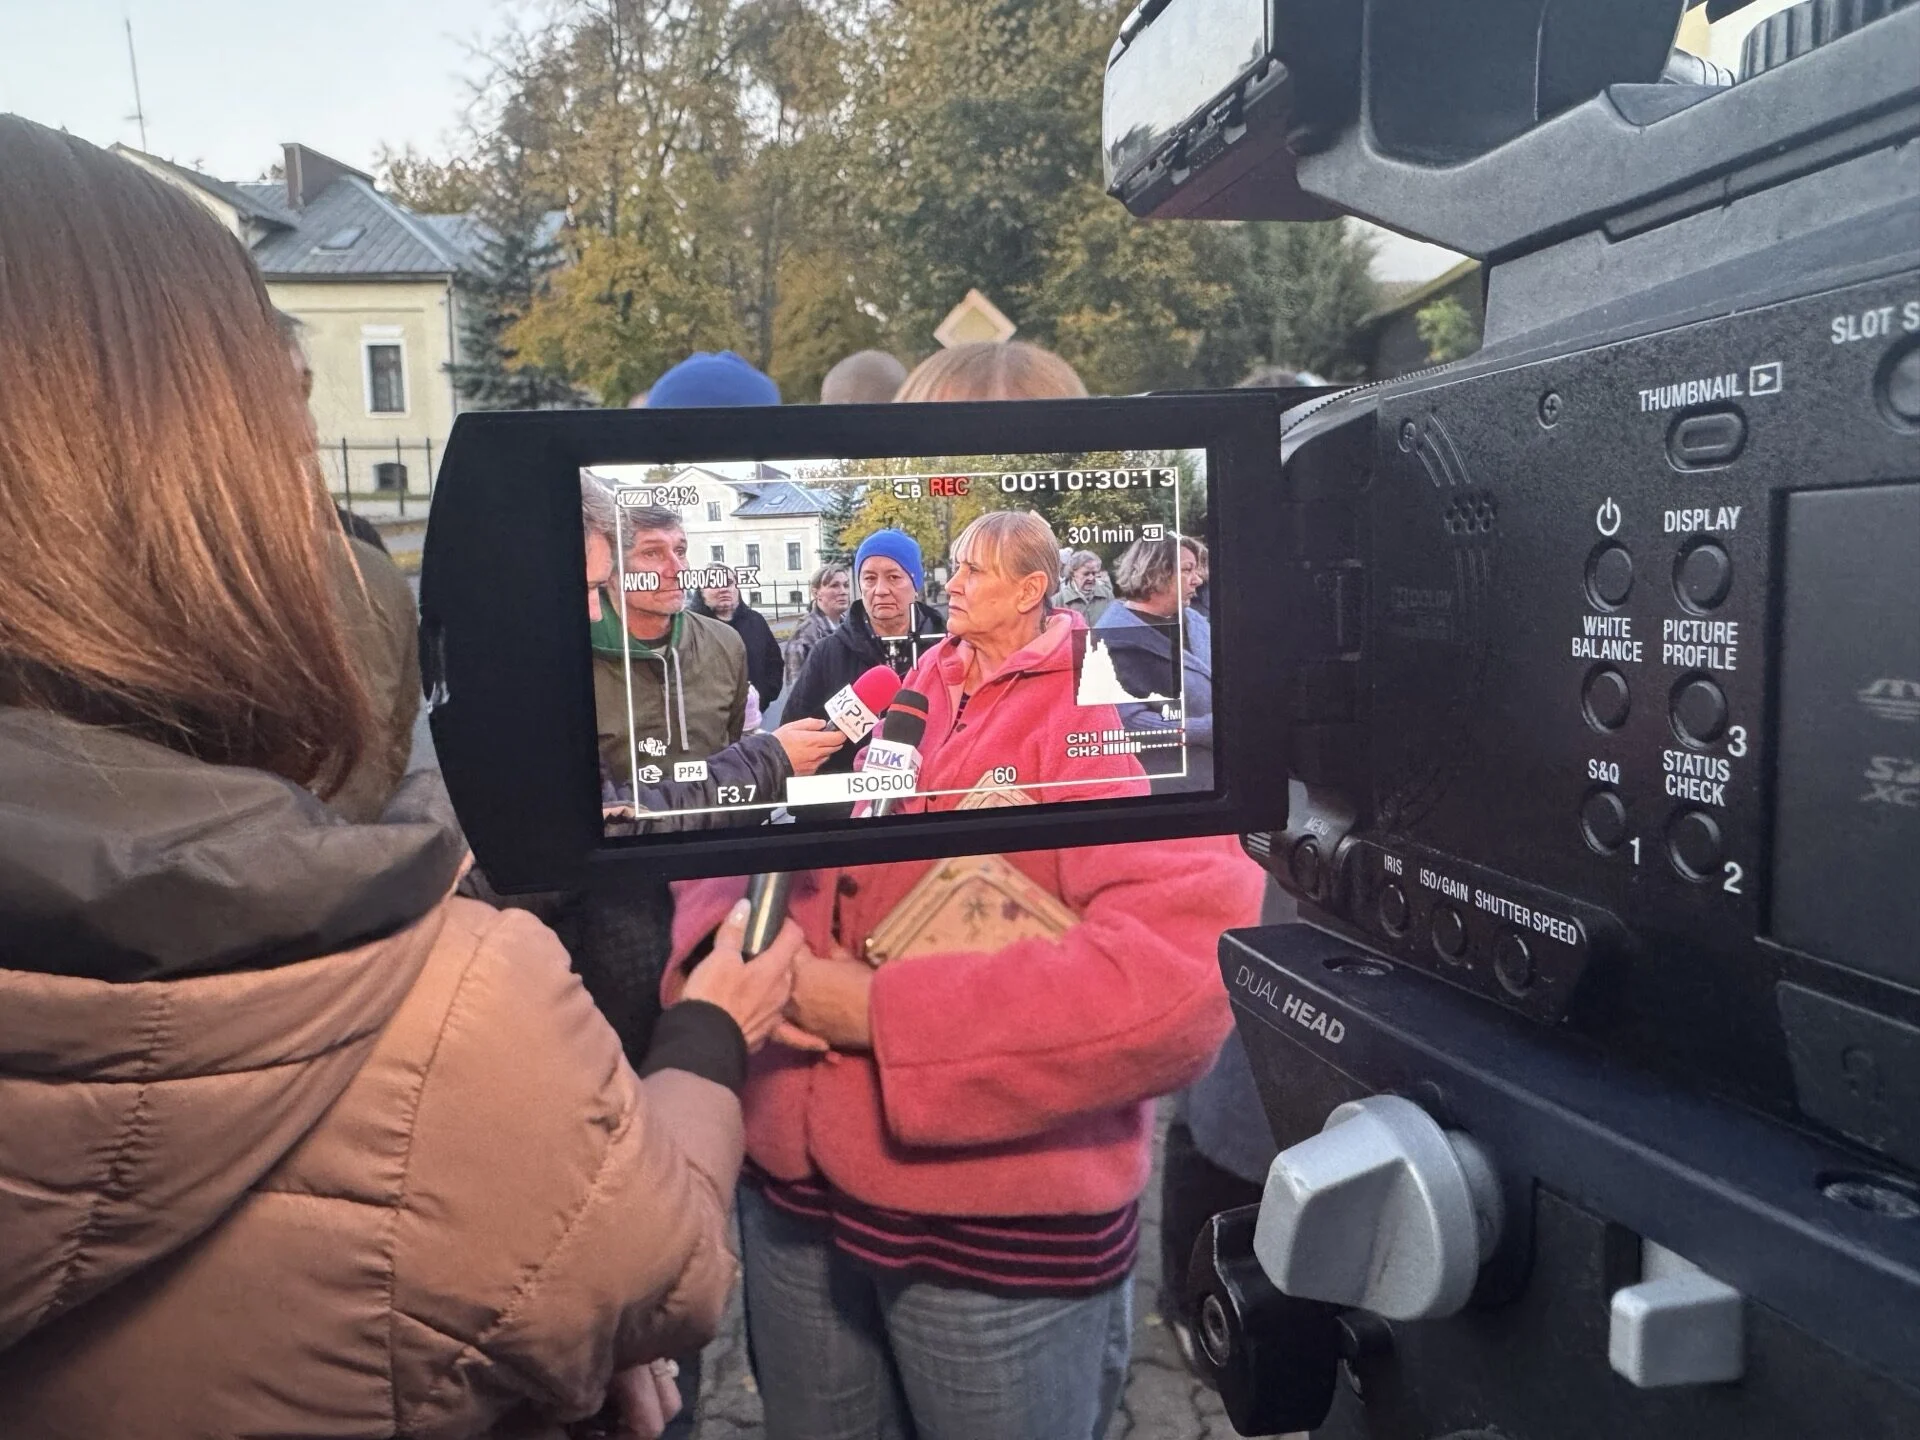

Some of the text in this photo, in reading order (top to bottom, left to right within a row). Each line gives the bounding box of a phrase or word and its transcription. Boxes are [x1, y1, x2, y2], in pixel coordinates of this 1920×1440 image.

[1831, 307, 1894, 345] SLOT
[1639, 373, 1744, 413] THUMBNAIL
[929, 476, 969, 497] REC
[1001, 469, 1175, 493] 00:10:30:13
[655, 487, 699, 506] 84%
[1664, 506, 1742, 533] DISPLAY
[623, 571, 660, 593] AVCHD
[676, 567, 729, 590] 1080/50i
[1583, 615, 1632, 639] WHITE
[1663, 619, 1739, 646] PICTURE
[1571, 637, 1643, 663] BALANCE
[1663, 644, 1737, 671] PROFILE
[1066, 731, 1098, 745] CH1
[1727, 725, 1748, 757] 3
[869, 748, 905, 768] TVK
[1066, 744, 1100, 758] CH2
[678, 766, 703, 778] PP4
[993, 766, 1017, 784] 60
[1588, 759, 1620, 785] S&Q
[1663, 750, 1730, 783] STATUS
[717, 784, 757, 805] F3.7
[847, 773, 915, 794] ISO500
[1665, 774, 1726, 807] CHECK
[1304, 816, 1329, 836] MENU
[1629, 837, 1641, 865] 1
[1384, 854, 1403, 876] IRIS
[1723, 861, 1744, 894] 2
[1419, 867, 1469, 903] ISO/GAIN
[1475, 889, 1577, 946] SHUTTER SPEED
[1235, 964, 1346, 1045] DUAL HEAD
